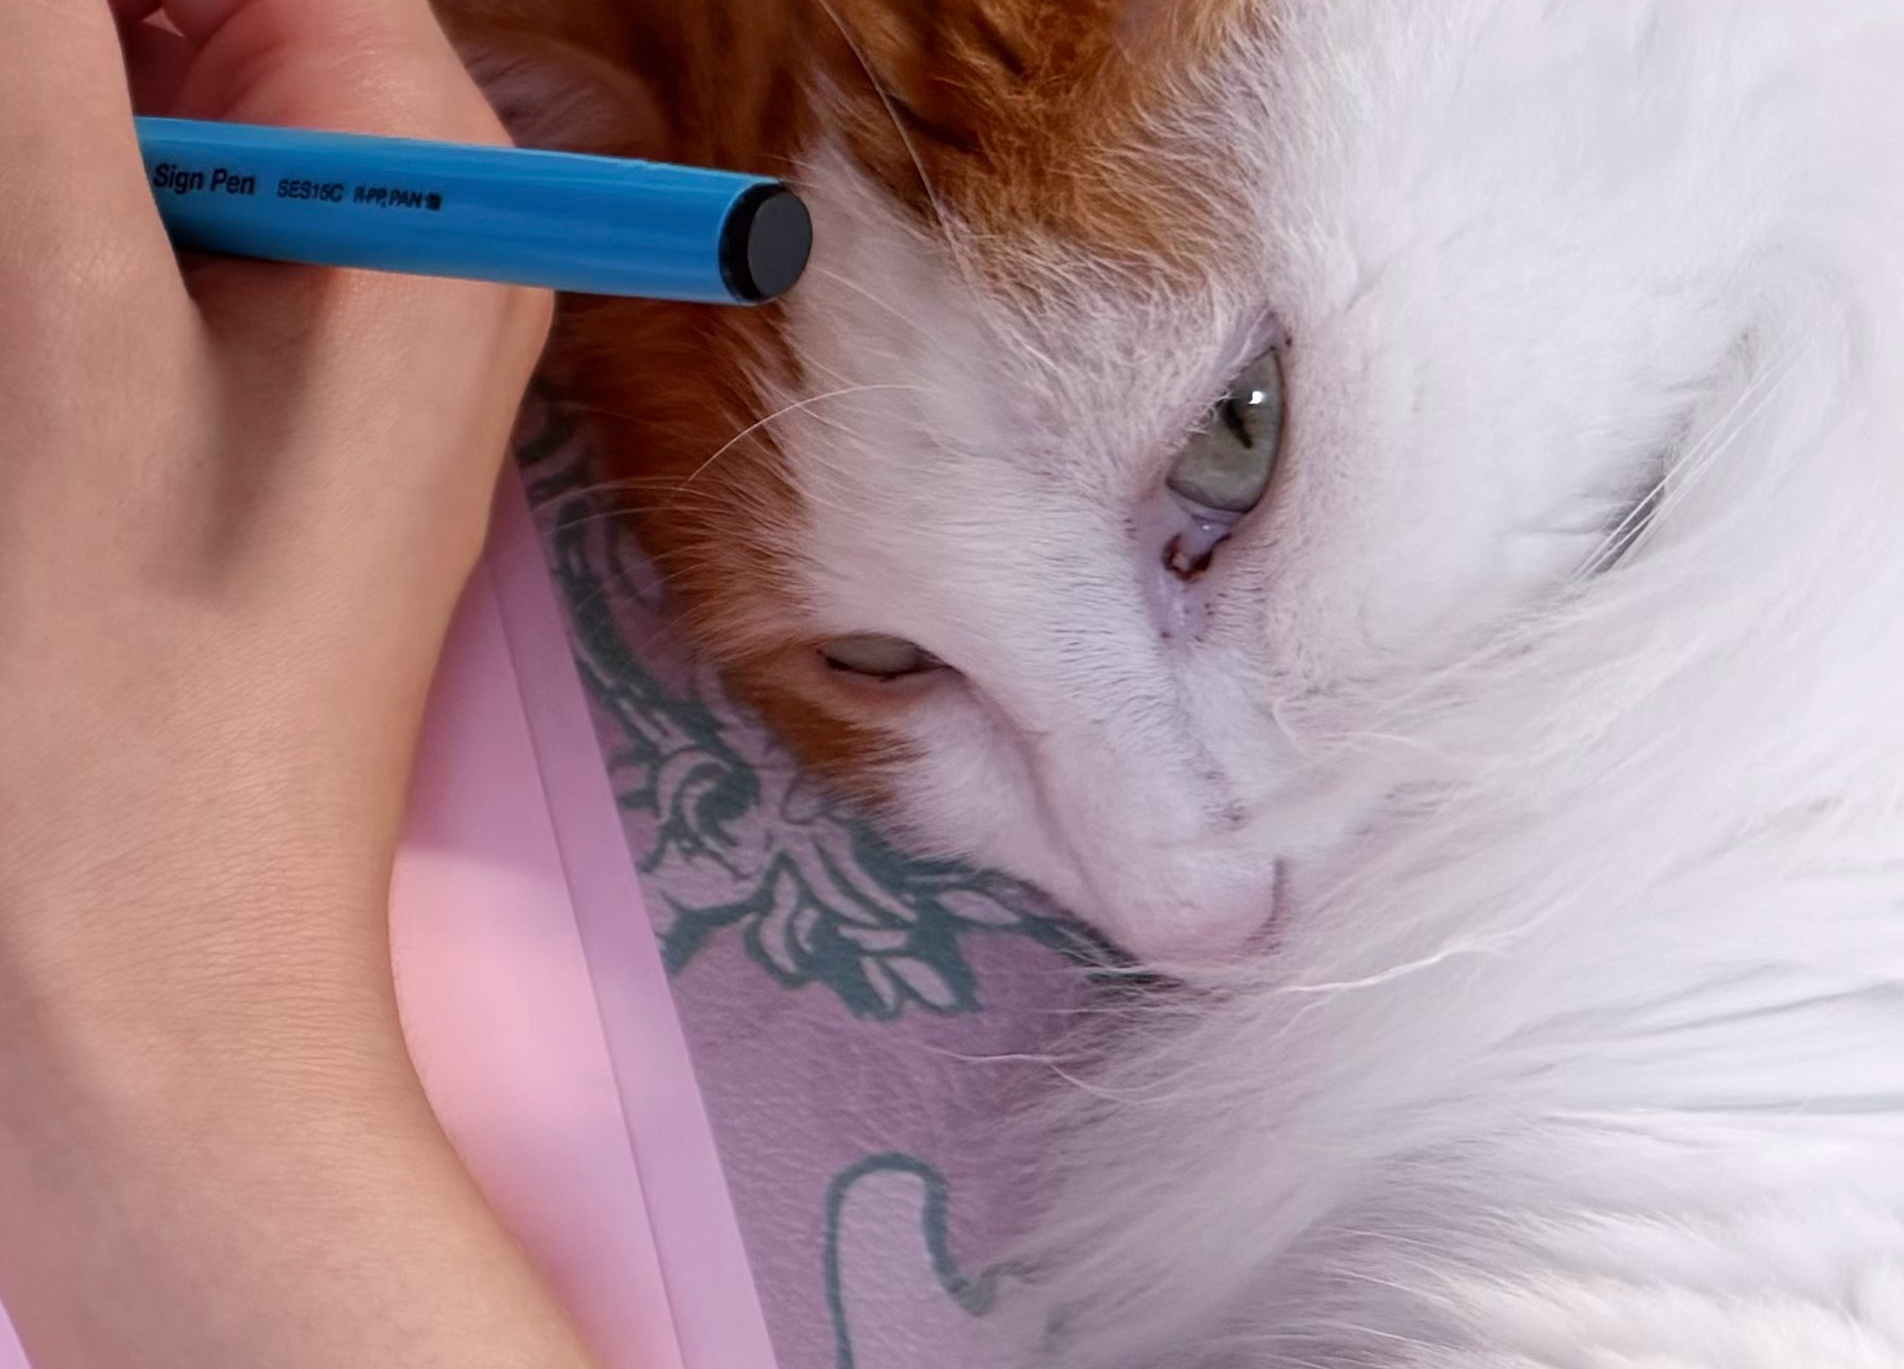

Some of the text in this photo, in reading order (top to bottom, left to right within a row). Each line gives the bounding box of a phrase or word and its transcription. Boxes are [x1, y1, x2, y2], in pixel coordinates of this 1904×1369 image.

[153, 162, 204, 196] Sign
[210, 167, 256, 196] Pen
[276, 178, 345, 204] SES15C
